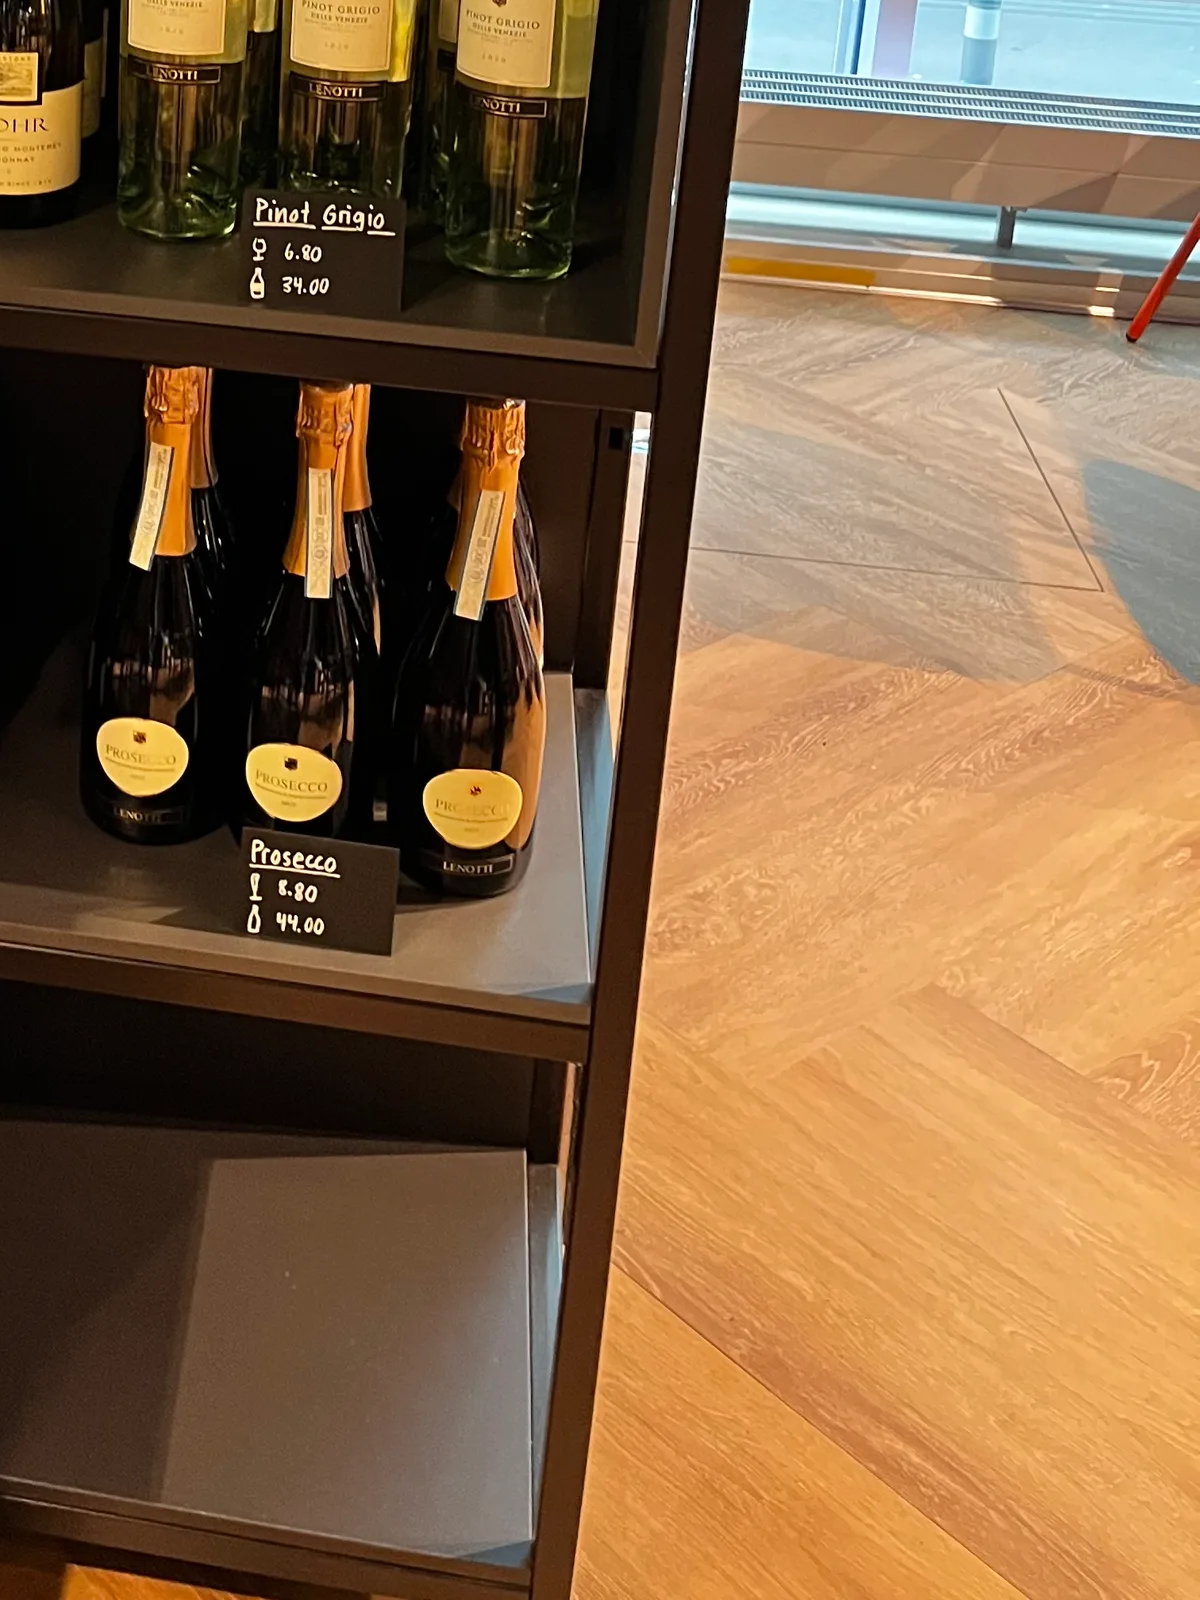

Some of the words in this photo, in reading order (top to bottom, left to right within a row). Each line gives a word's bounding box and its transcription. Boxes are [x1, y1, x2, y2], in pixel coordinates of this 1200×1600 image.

[338, 5, 380, 15] GRIGIO
[466, 9, 492, 24] PINOT
[496, 17, 540, 30] GRIGIO
[309, 83, 362, 98] LENOTTI
[481, 98, 520, 113] NOTTI
[255, 197, 310, 223] Pinot
[322, 203, 385, 232] Grigio
[284, 243, 322, 262] 6.80
[282, 276, 329, 295] 34.00
[105, 744, 176, 765] PROSEO
[256, 769, 327, 792] PROSECCO
[435, 798, 509, 817] PROECCO
[250, 838, 337, 873] Prosecco
[443, 861, 493, 873] LENOTTI
[278, 881, 318, 903] 8.80
[276, 911, 325, 936] 44.00
